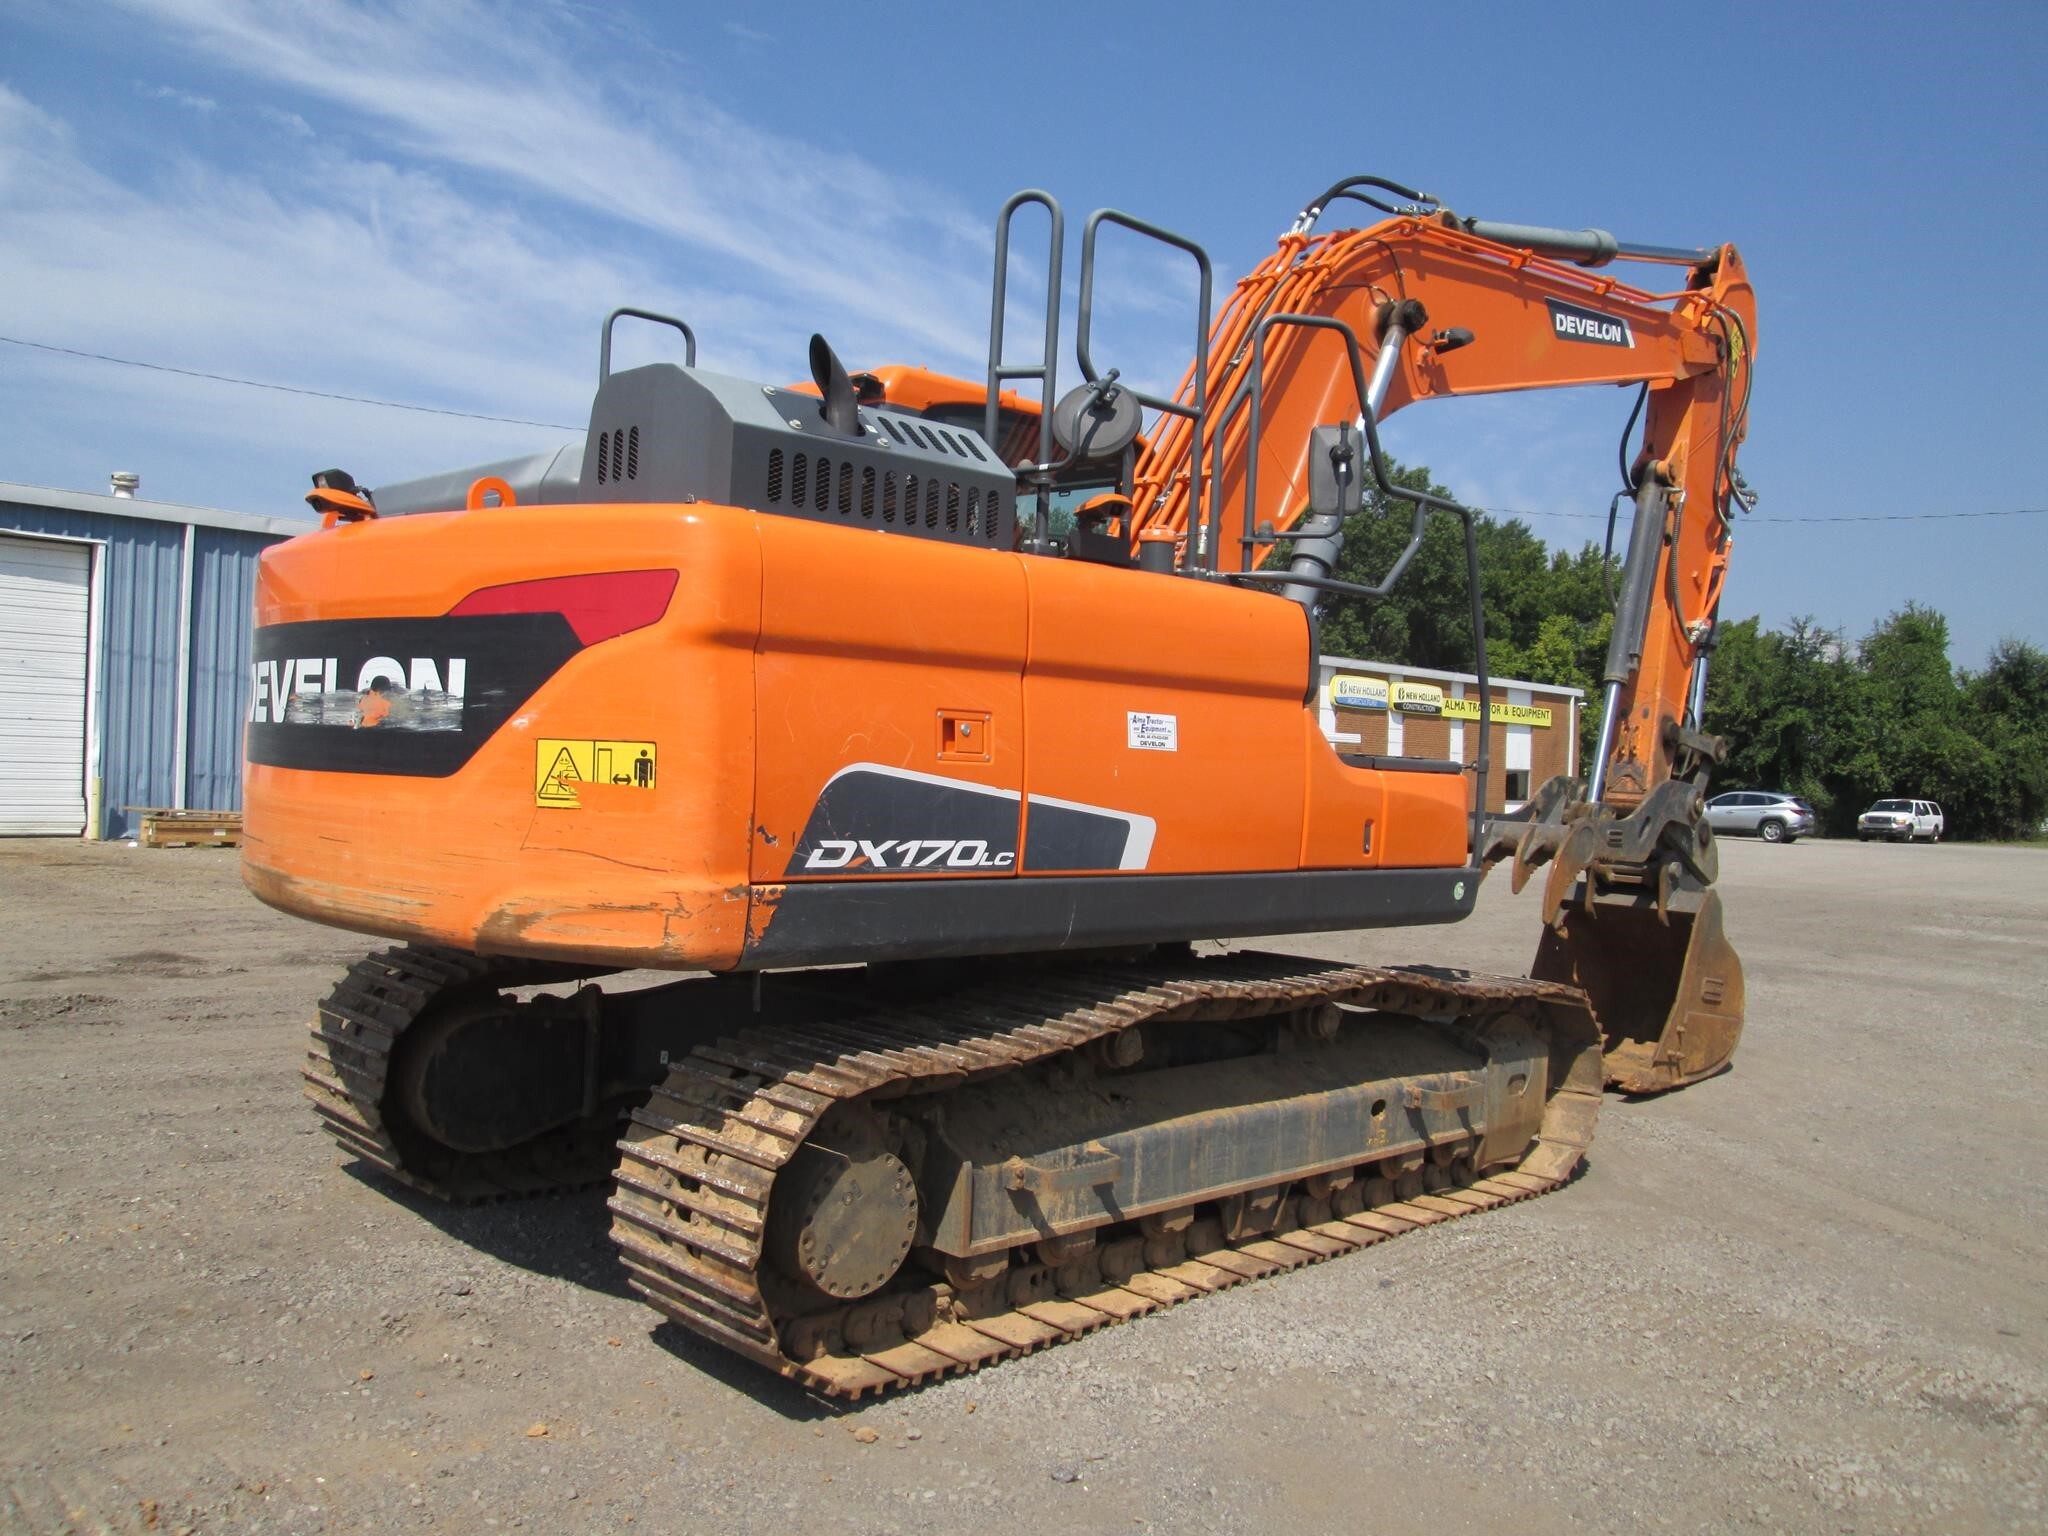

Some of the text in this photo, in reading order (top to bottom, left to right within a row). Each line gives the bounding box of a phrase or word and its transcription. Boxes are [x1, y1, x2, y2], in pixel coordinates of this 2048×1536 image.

[1555, 313, 1621, 342] DEVELON
[1348, 685, 1386, 697] NEW HOLLAND
[1405, 692, 1440, 702] NEW HOLLAND
[1402, 703, 1436, 712] CONSTRUCTION
[1444, 699, 1550, 720] ALMA TRAOR & EQUIPMENT
